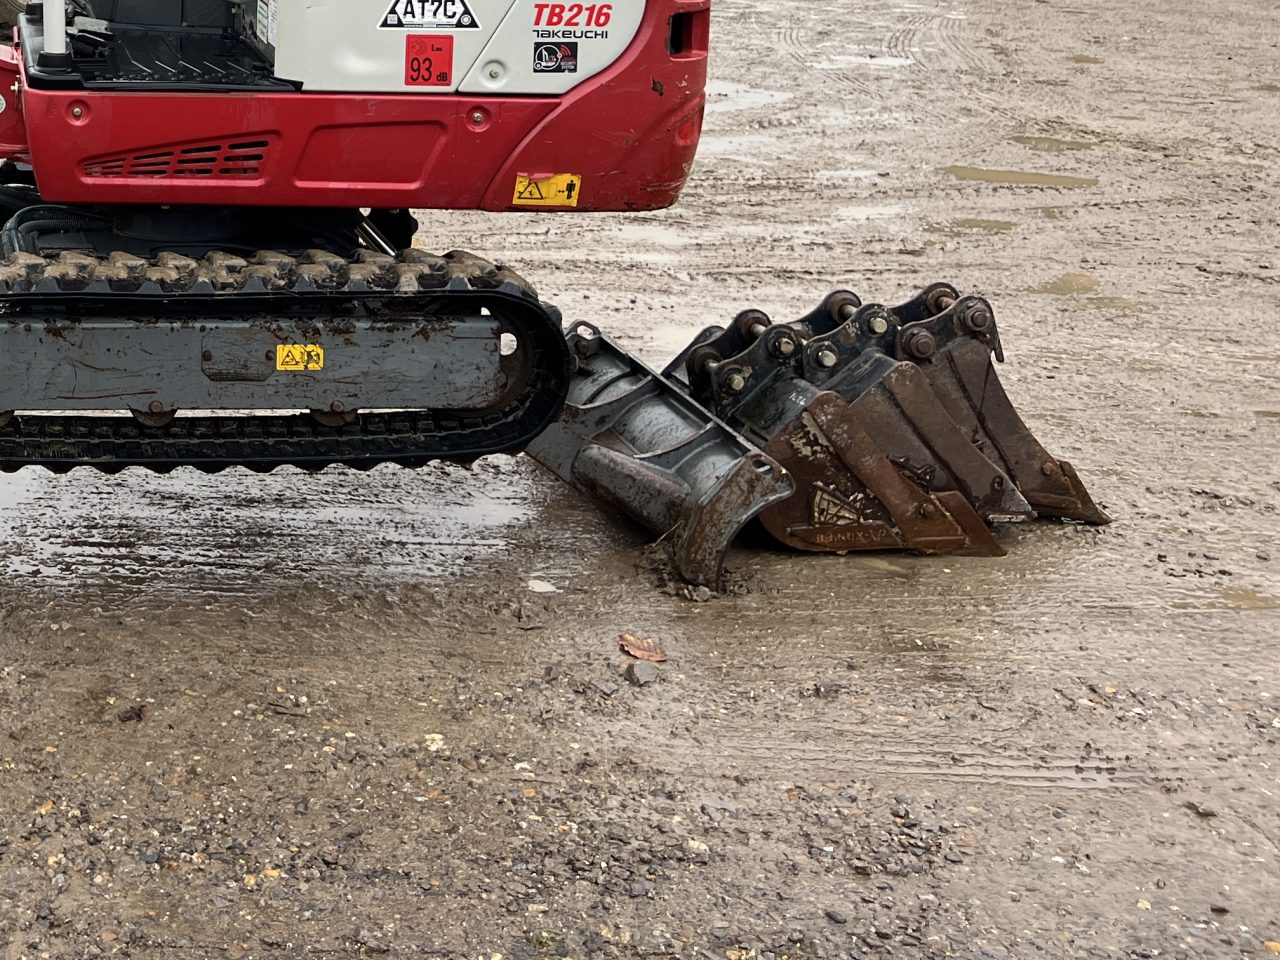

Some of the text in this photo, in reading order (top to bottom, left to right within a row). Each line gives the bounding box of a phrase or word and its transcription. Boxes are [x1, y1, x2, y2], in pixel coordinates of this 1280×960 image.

[533, 3, 613, 28] TB216
[532, 29, 609, 39] TAKEUCHI
[409, 57, 448, 82] 93 dB
